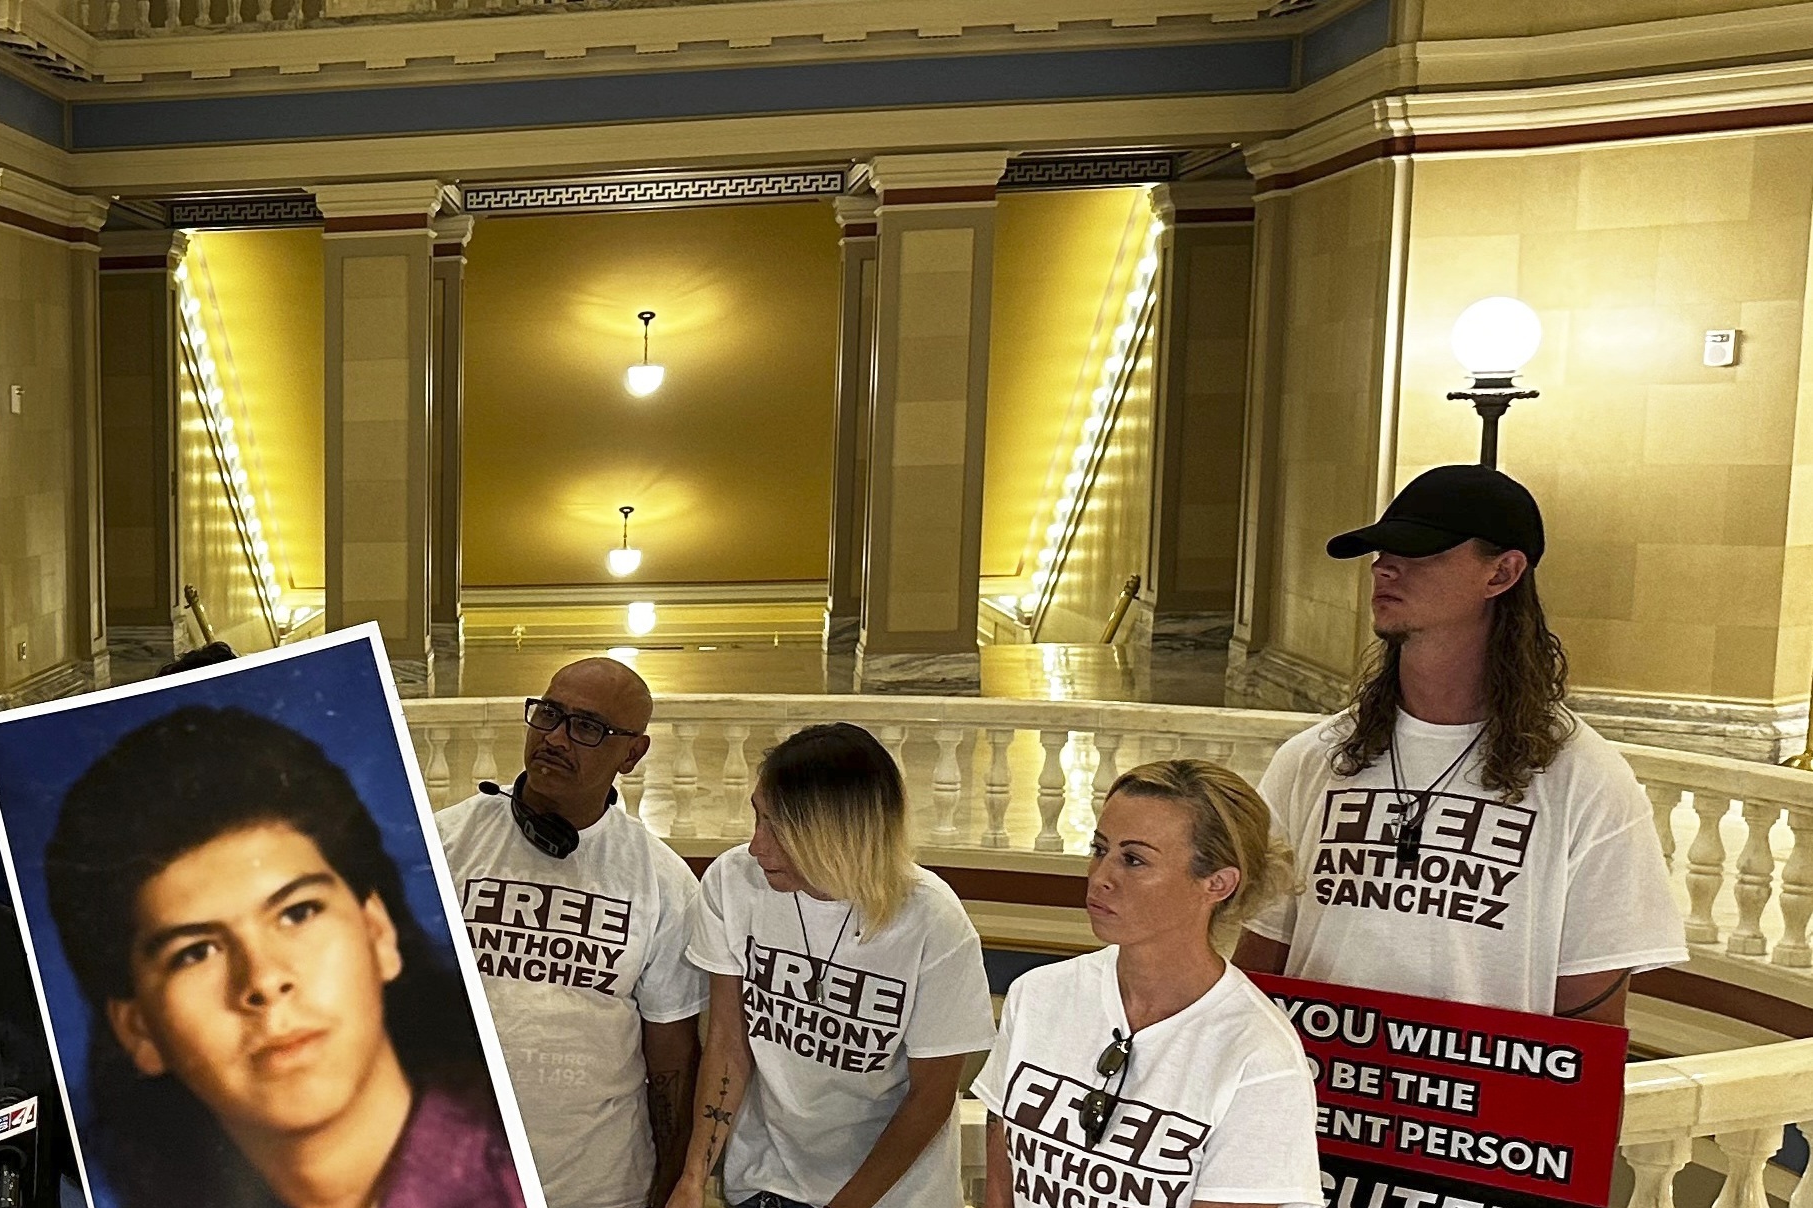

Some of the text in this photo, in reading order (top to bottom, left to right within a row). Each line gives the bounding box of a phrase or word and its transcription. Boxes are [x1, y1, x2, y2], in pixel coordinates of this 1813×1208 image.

[1322, 792, 1532, 863] FREE
[1314, 848, 1520, 896] ANTHONY
[463, 881, 629, 942] FREE
[1316, 878, 1509, 930] SANCHEZ
[477, 953, 618, 995] ANCHEZ
[749, 949, 904, 1024] FREE
[1388, 1022, 1577, 1079] WILLING
[11, 1104, 36, 1126] 4
[1332, 1062, 1380, 1094] BE
[1392, 1072, 1474, 1113] THE
[1006, 1067, 1206, 1172] FREE
[1400, 1121, 1569, 1180] PERSON
